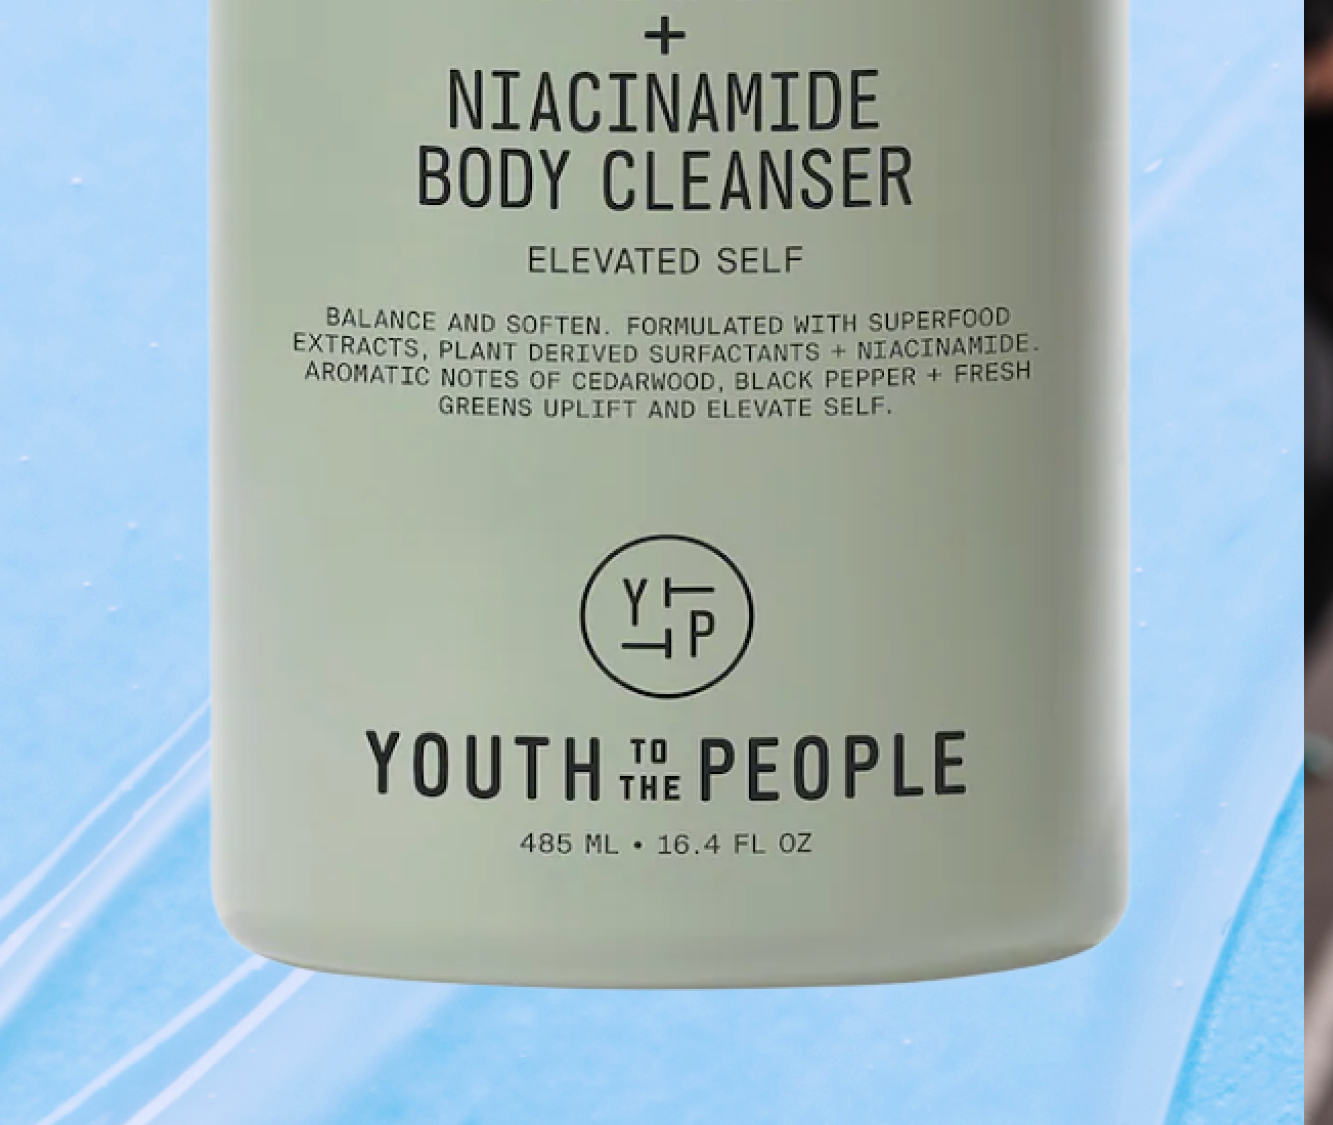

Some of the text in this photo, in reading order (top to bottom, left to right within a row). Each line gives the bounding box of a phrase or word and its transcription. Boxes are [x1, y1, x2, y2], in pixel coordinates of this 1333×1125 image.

[644, 15, 686, 56] +
[449, 69, 879, 134] NIACINAMIDE
[418, 144, 912, 212] BODY CLEANSER
[529, 245, 803, 275] ELEVATED SELF
[326, 306, 1010, 337] BALANCE AND SOFTEN. FORMULATED WITH SUPERFOOD
[293, 332, 1039, 364] EXTRACTS, PLANT DERIVED SURFACTANTS + NIACINAMIDE.
[304, 359, 1030, 394] AROMATIC NOTES OF CEDARWOOD, BLACK PEPPER + FRESH
[439, 394, 891, 419] GREENS UPLIFT AND ELEVATE SELF.
[365, 730, 967, 802] YOUTH TO THE PEOPLE
[519, 832, 572, 855] 485
[585, 833, 619, 855] ML
[658, 833, 721, 855] 16.4
[734, 833, 766, 854] FL
[779, 832, 813, 854] OZ
